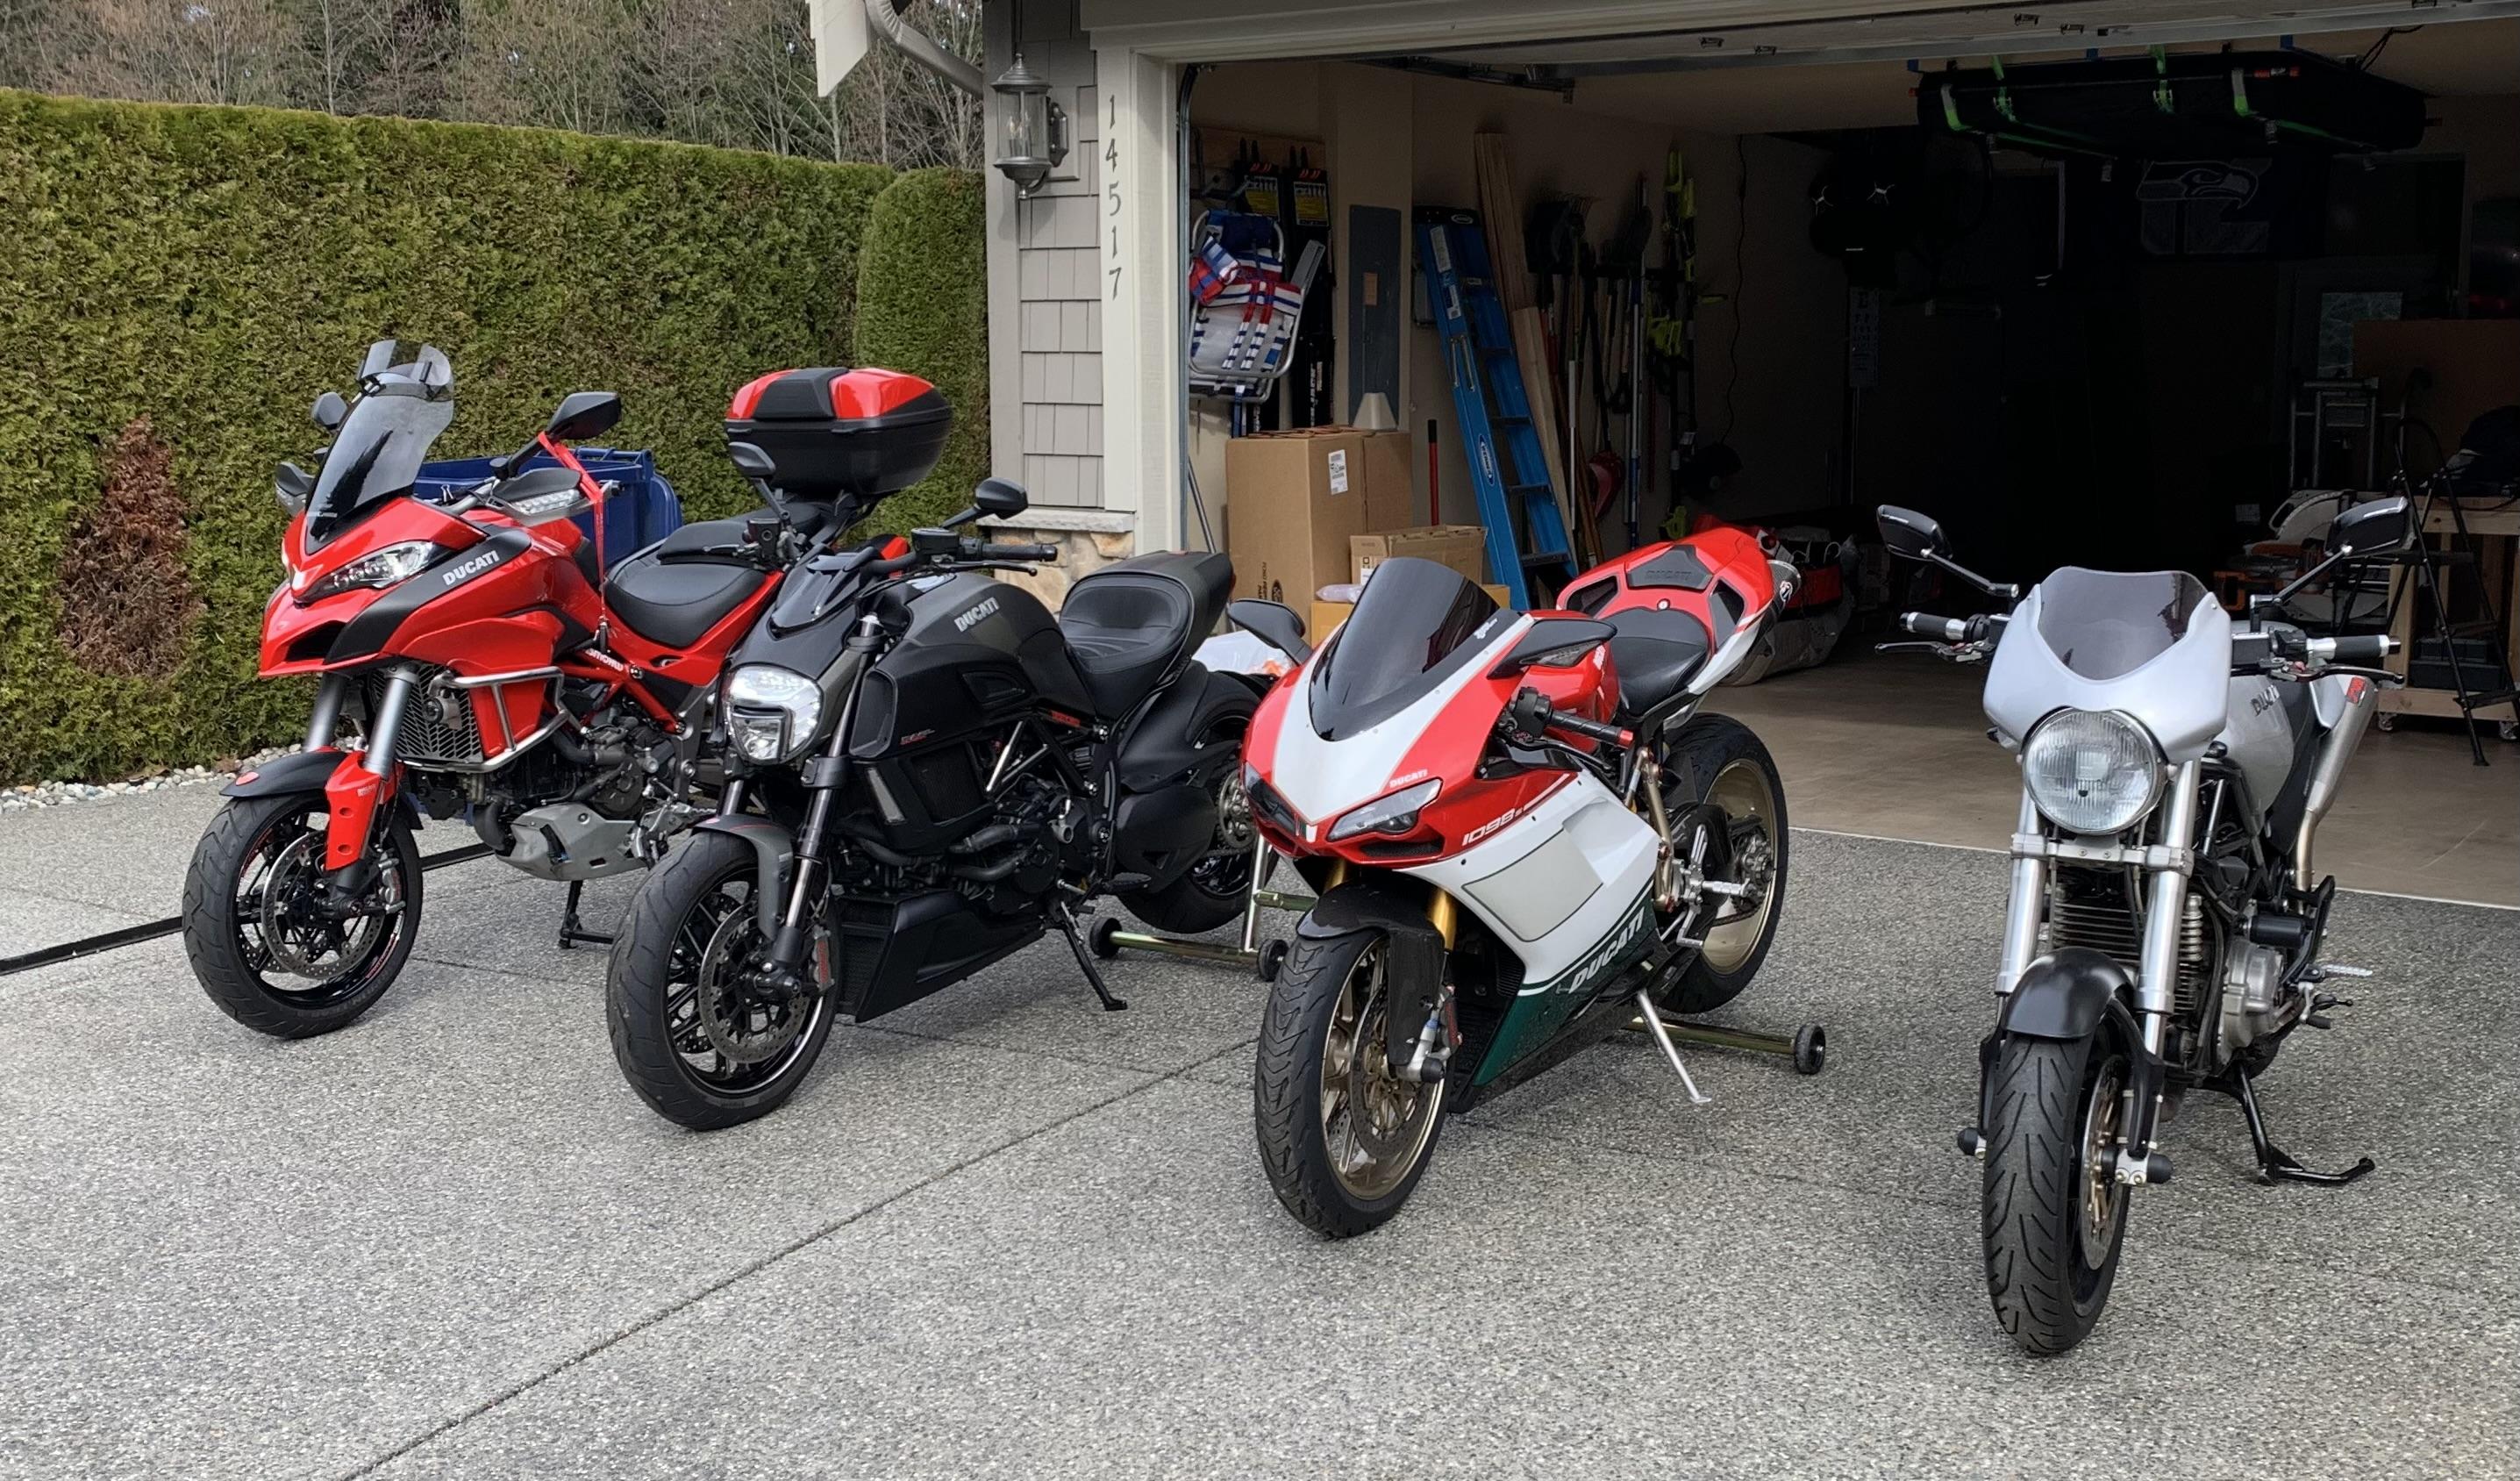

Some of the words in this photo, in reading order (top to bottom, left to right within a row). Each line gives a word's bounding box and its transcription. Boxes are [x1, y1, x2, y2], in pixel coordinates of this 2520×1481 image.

[1105, 94, 1122, 301] 14517
[442, 549, 500, 586] DUCATI
[953, 596, 1000, 633] DUCATI
[1388, 769, 1429, 789] DUCATI
[1567, 905, 1645, 994] DUCATI
